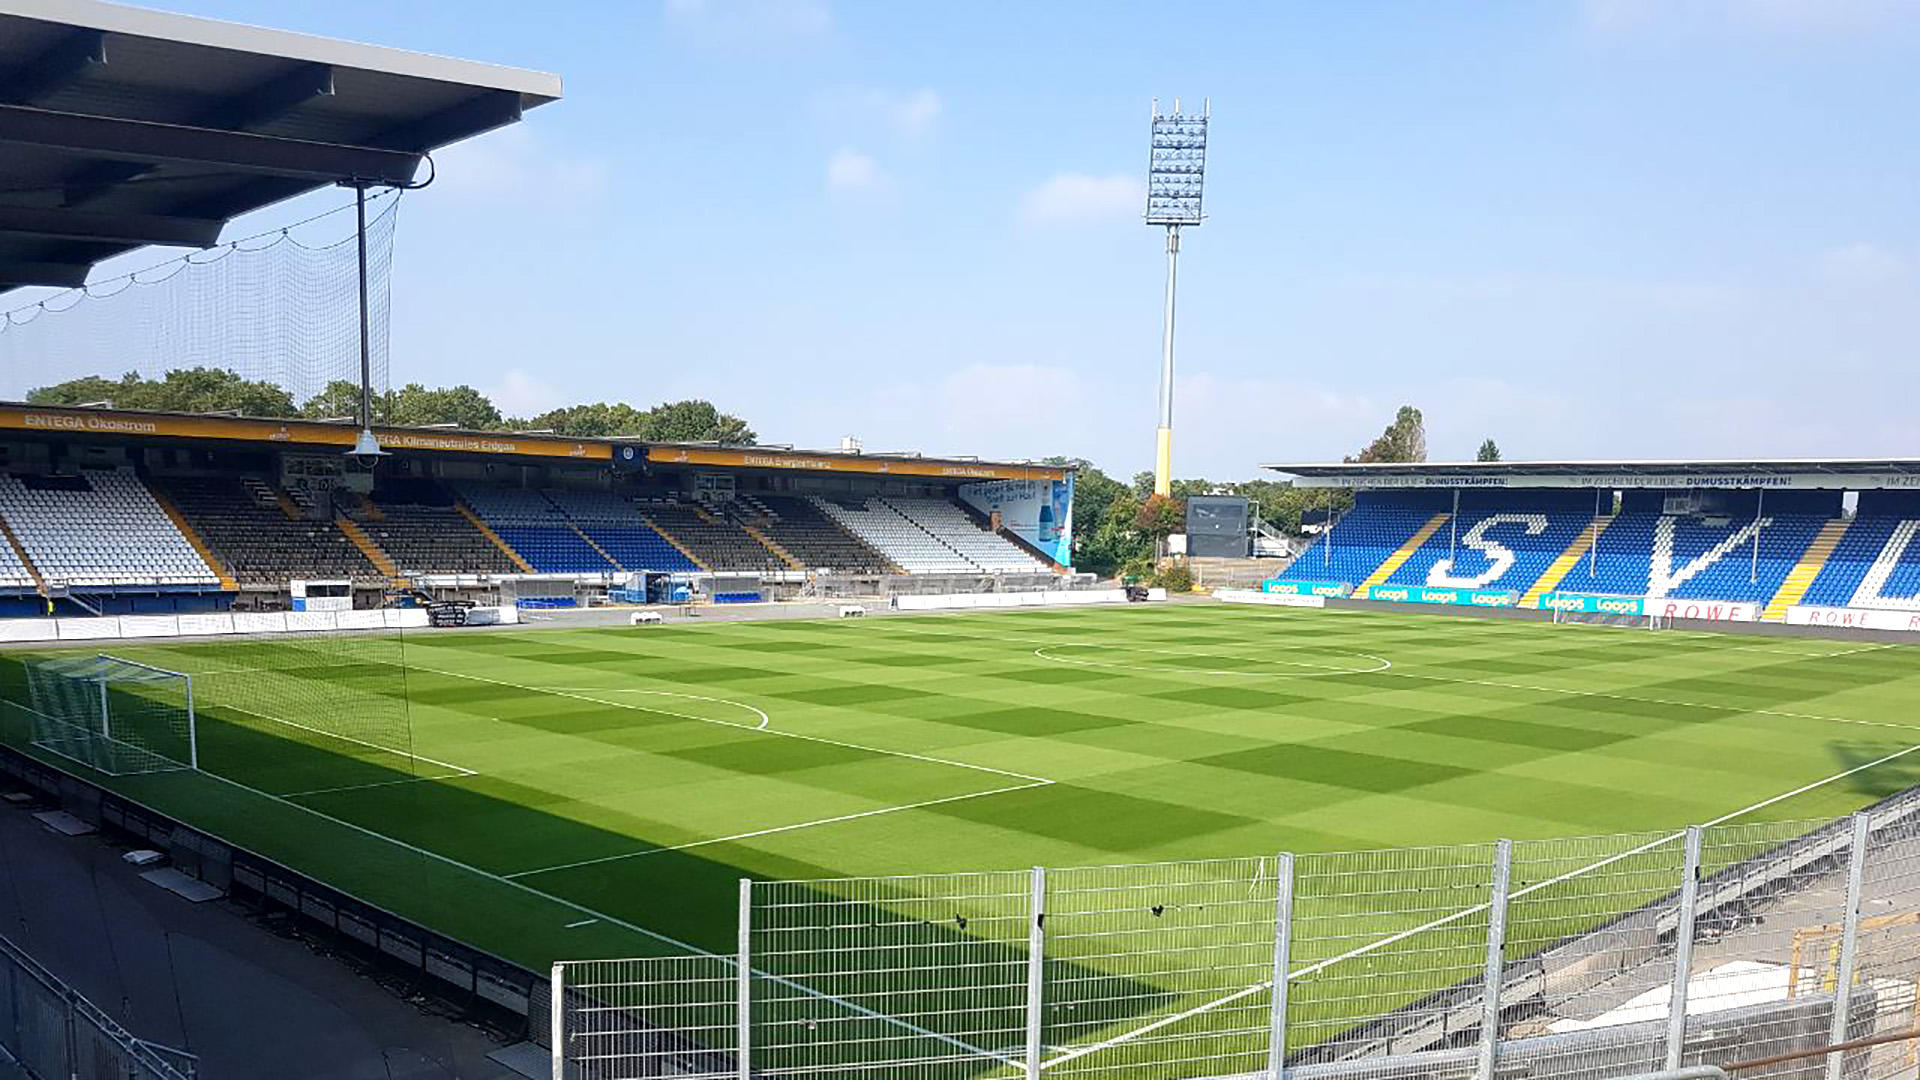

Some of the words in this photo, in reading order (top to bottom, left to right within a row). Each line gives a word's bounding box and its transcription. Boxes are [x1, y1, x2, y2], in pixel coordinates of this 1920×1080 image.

[24, 415, 84, 428] ENTEGA
[1663, 604, 1742, 623] ROWE
[1809, 611, 1869, 625] ROWE
